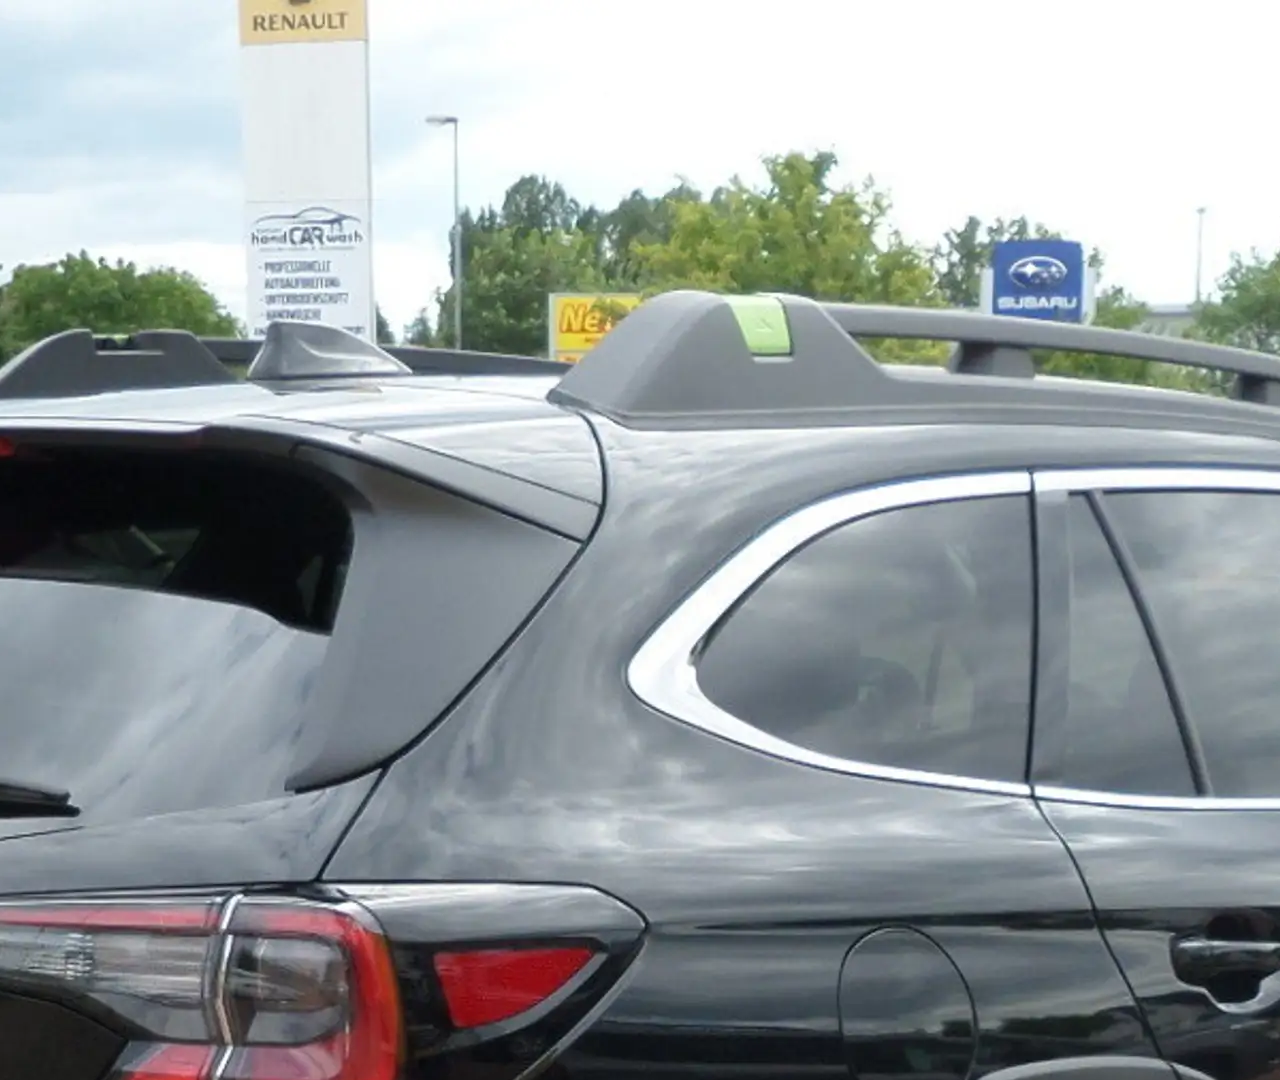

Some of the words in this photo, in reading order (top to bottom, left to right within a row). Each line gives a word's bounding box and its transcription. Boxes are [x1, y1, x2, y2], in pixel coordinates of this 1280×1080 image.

[252, 11, 348, 31] RENAULT
[251, 231, 287, 245] hand
[289, 226, 324, 245] CAR
[326, 230, 363, 243] wash
[997, 296, 1077, 309] SUBARU
